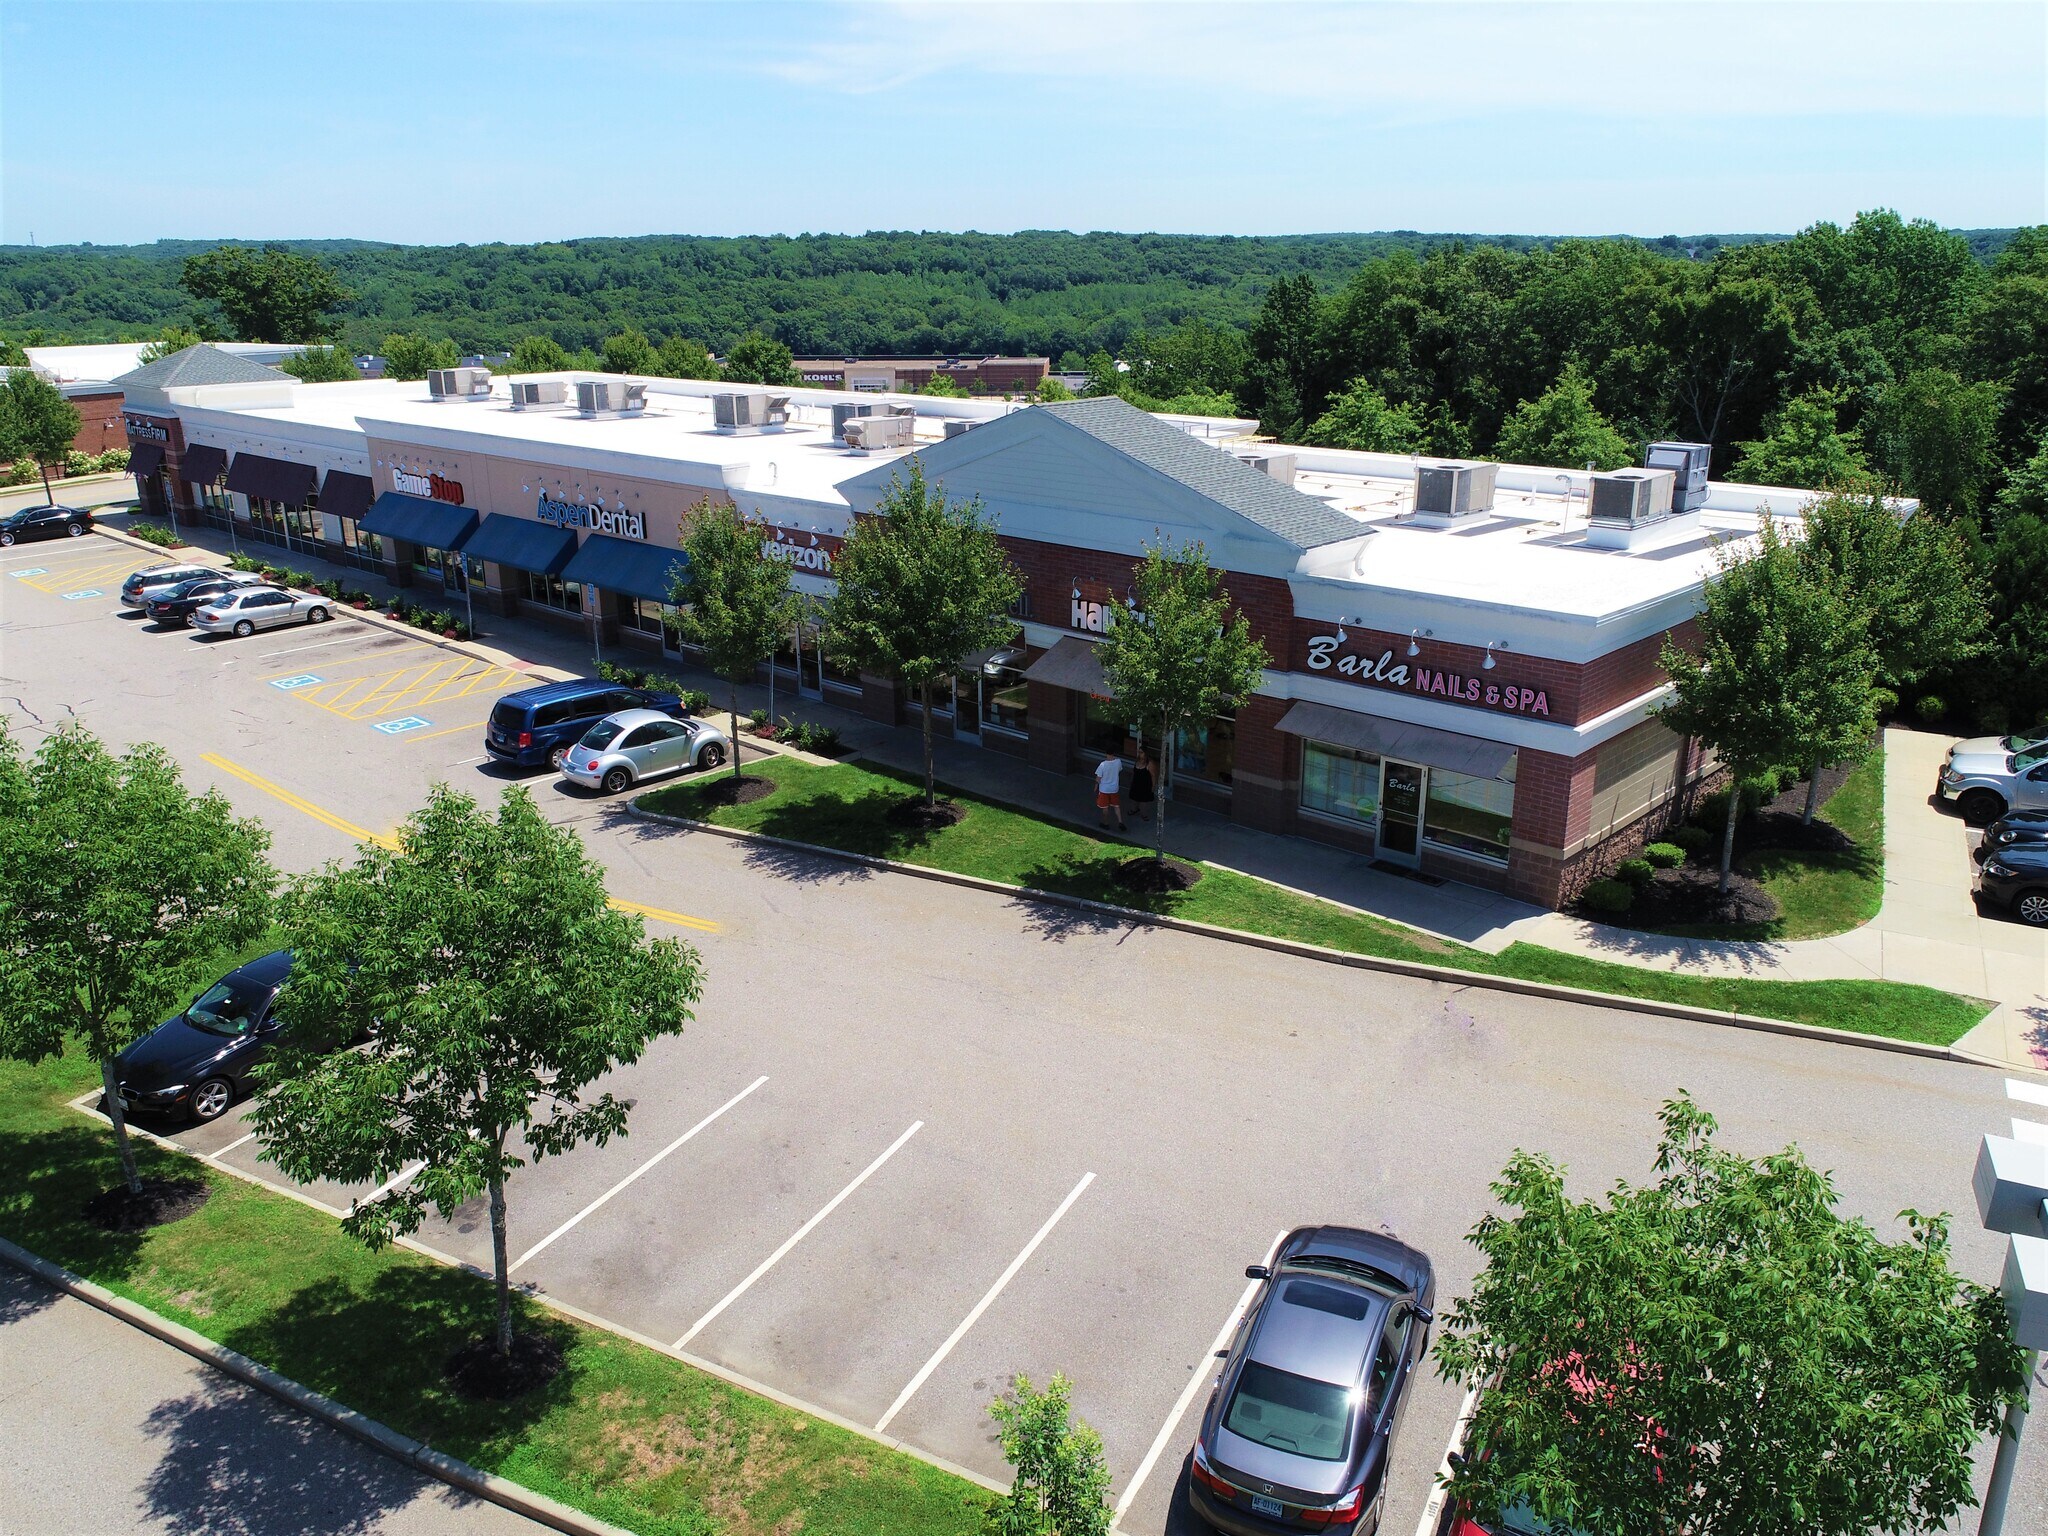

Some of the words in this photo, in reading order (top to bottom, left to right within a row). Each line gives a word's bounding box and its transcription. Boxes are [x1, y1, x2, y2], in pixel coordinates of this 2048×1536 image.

[392, 467, 465, 506] GameStop
[760, 538, 832, 573] verizon
[1307, 635, 1412, 686] Barla
[1415, 668, 1481, 702] NAILS
[1485, 685, 1501, 705] &
[1503, 686, 1550, 716] SPA
[1389, 778, 1417, 793] Barla
